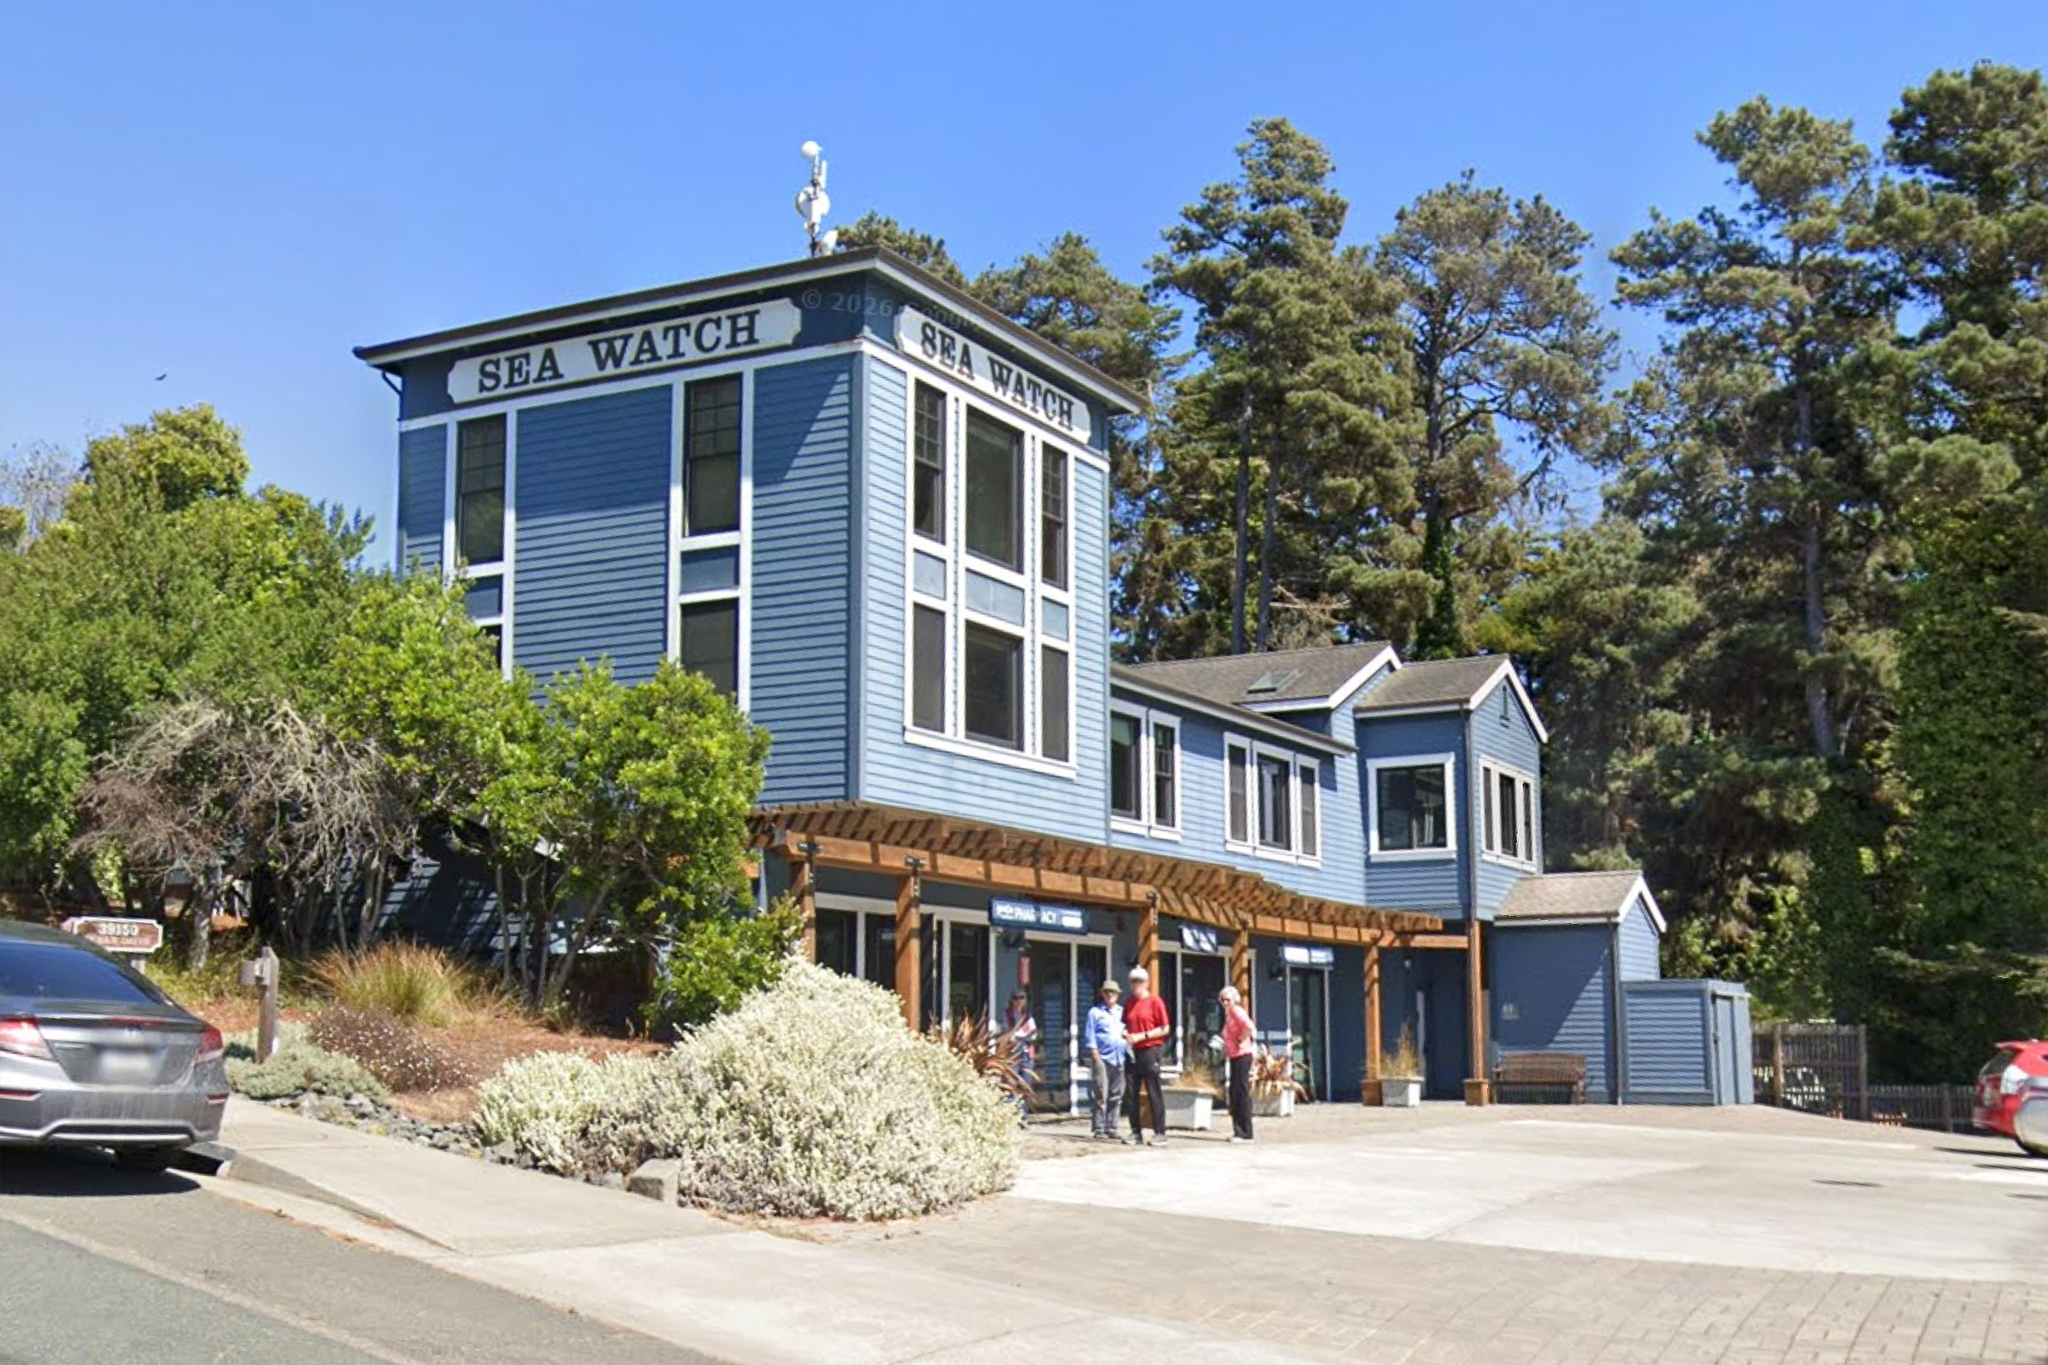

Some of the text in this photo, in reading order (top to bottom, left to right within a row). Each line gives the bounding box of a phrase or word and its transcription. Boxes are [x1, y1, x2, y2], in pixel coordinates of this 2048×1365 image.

[478, 309, 760, 393] SEA WATCH
[920, 321, 1074, 431] SEA WATCH
